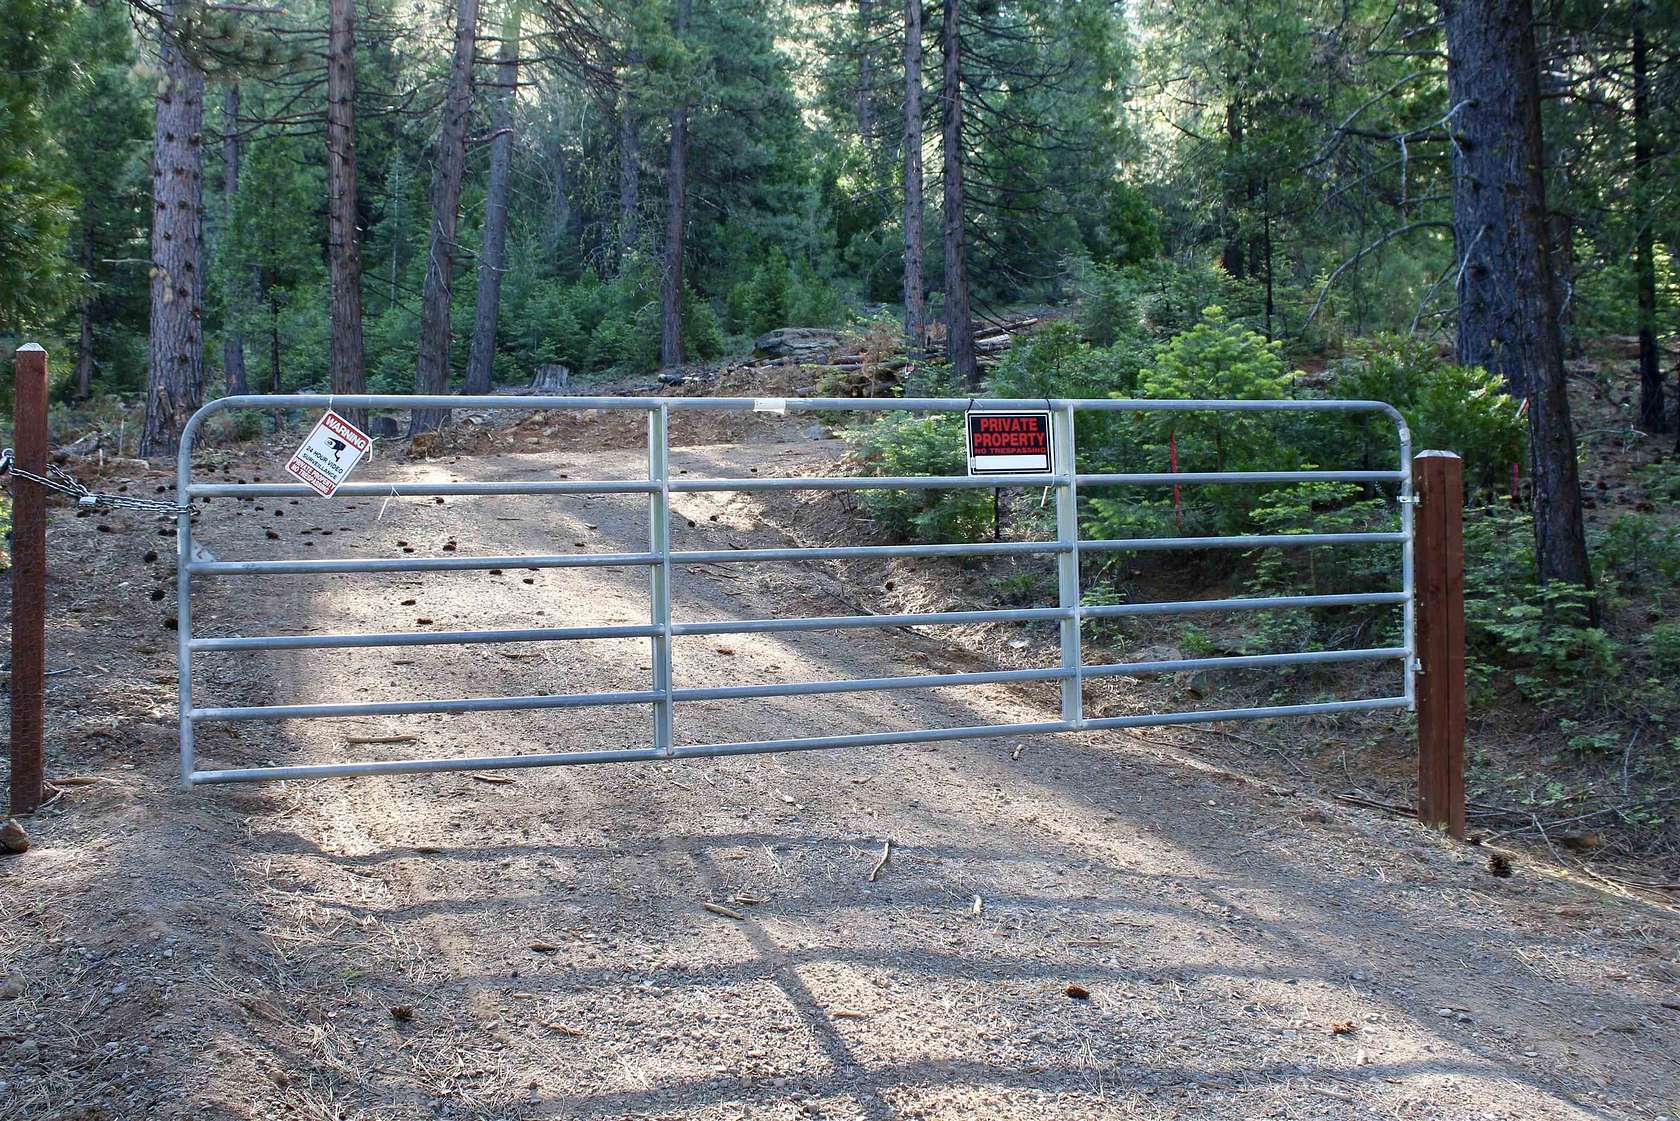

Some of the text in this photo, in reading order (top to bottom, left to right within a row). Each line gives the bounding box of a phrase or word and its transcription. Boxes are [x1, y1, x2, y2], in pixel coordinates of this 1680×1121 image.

[324, 415, 367, 449] WARNING
[980, 418, 1038, 431] PRIVATE
[974, 433, 1044, 446] PROPERTY
[292, 457, 335, 490] PRIVATE PROPERTY
[301, 452, 337, 480] SURVEILLANCE
[305, 445, 343, 474] 24 HOUR VIDEO
[290, 463, 329, 493] NO TRESPASSING
